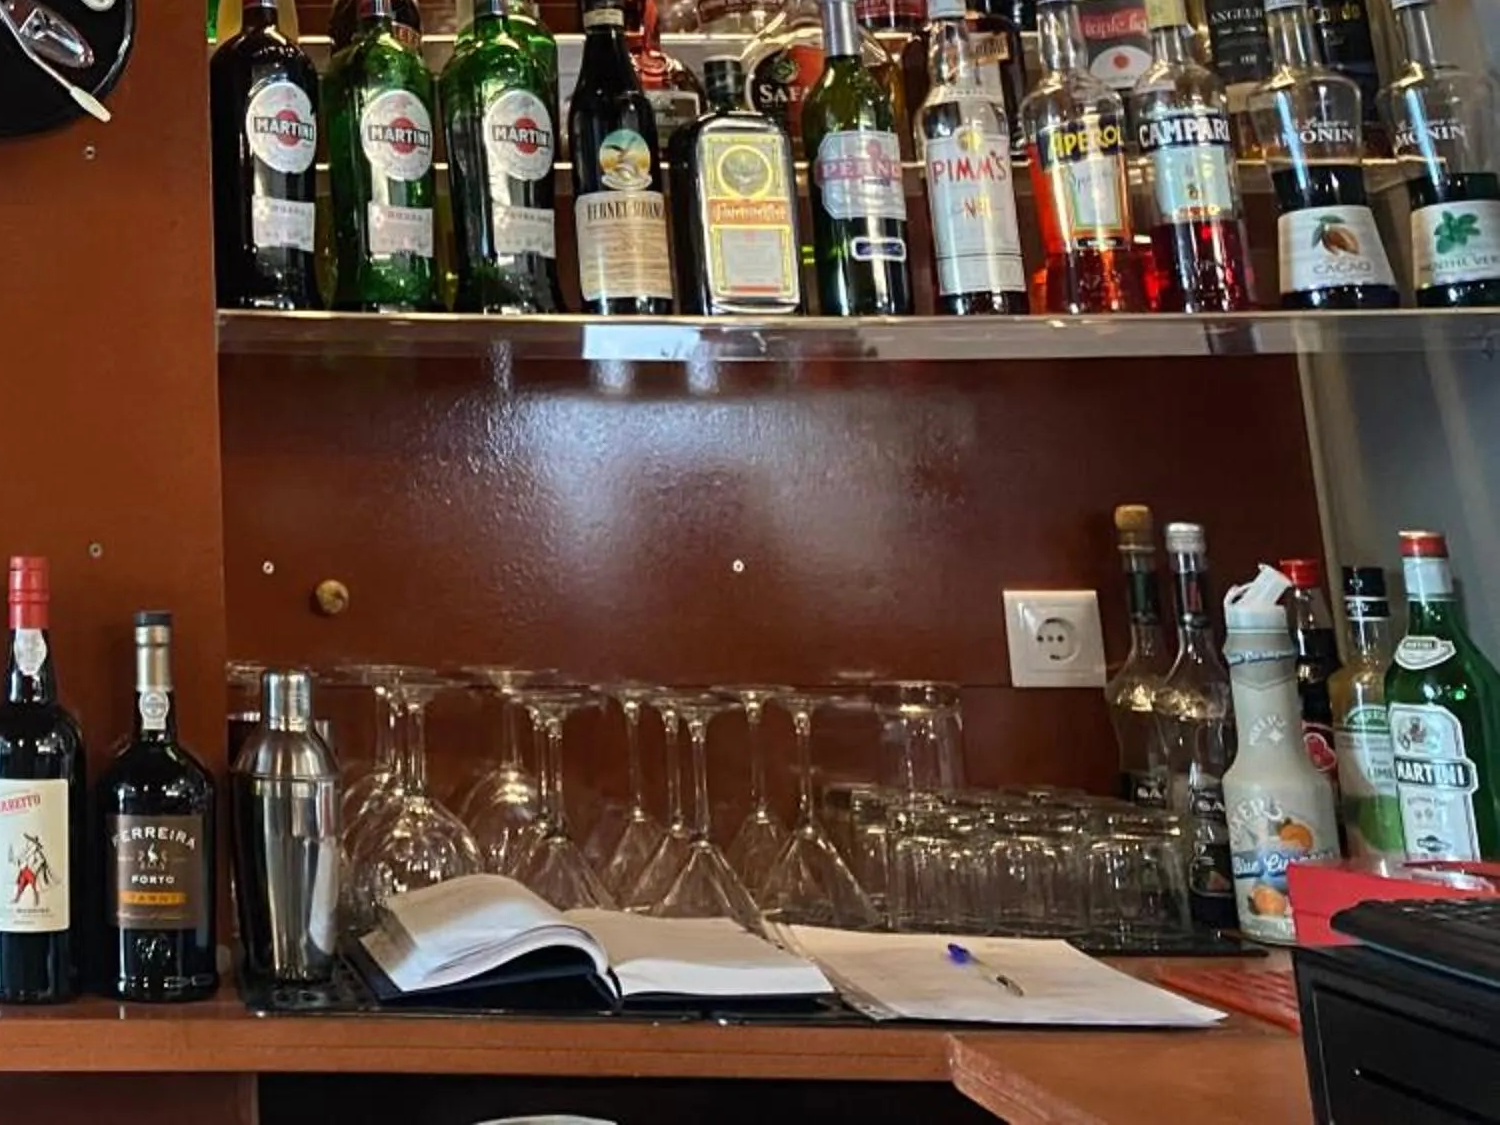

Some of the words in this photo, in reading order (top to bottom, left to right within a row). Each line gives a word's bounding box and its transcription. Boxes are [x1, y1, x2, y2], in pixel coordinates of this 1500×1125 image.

[256, 118, 314, 141] MARTINI
[370, 126, 430, 148] MARTINI
[1051, 124, 1125, 156] APEROL
[1139, 116, 1231, 147] CAMPARI
[931, 153, 1009, 184] PIMM'S
[1312, 261, 1372, 275] CACAO
[1397, 759, 1465, 786] MARTINI
[111, 826, 196, 851] FERREIRA
[1234, 853, 1261, 875] Blue
[131, 875, 176, 885] PORTO
